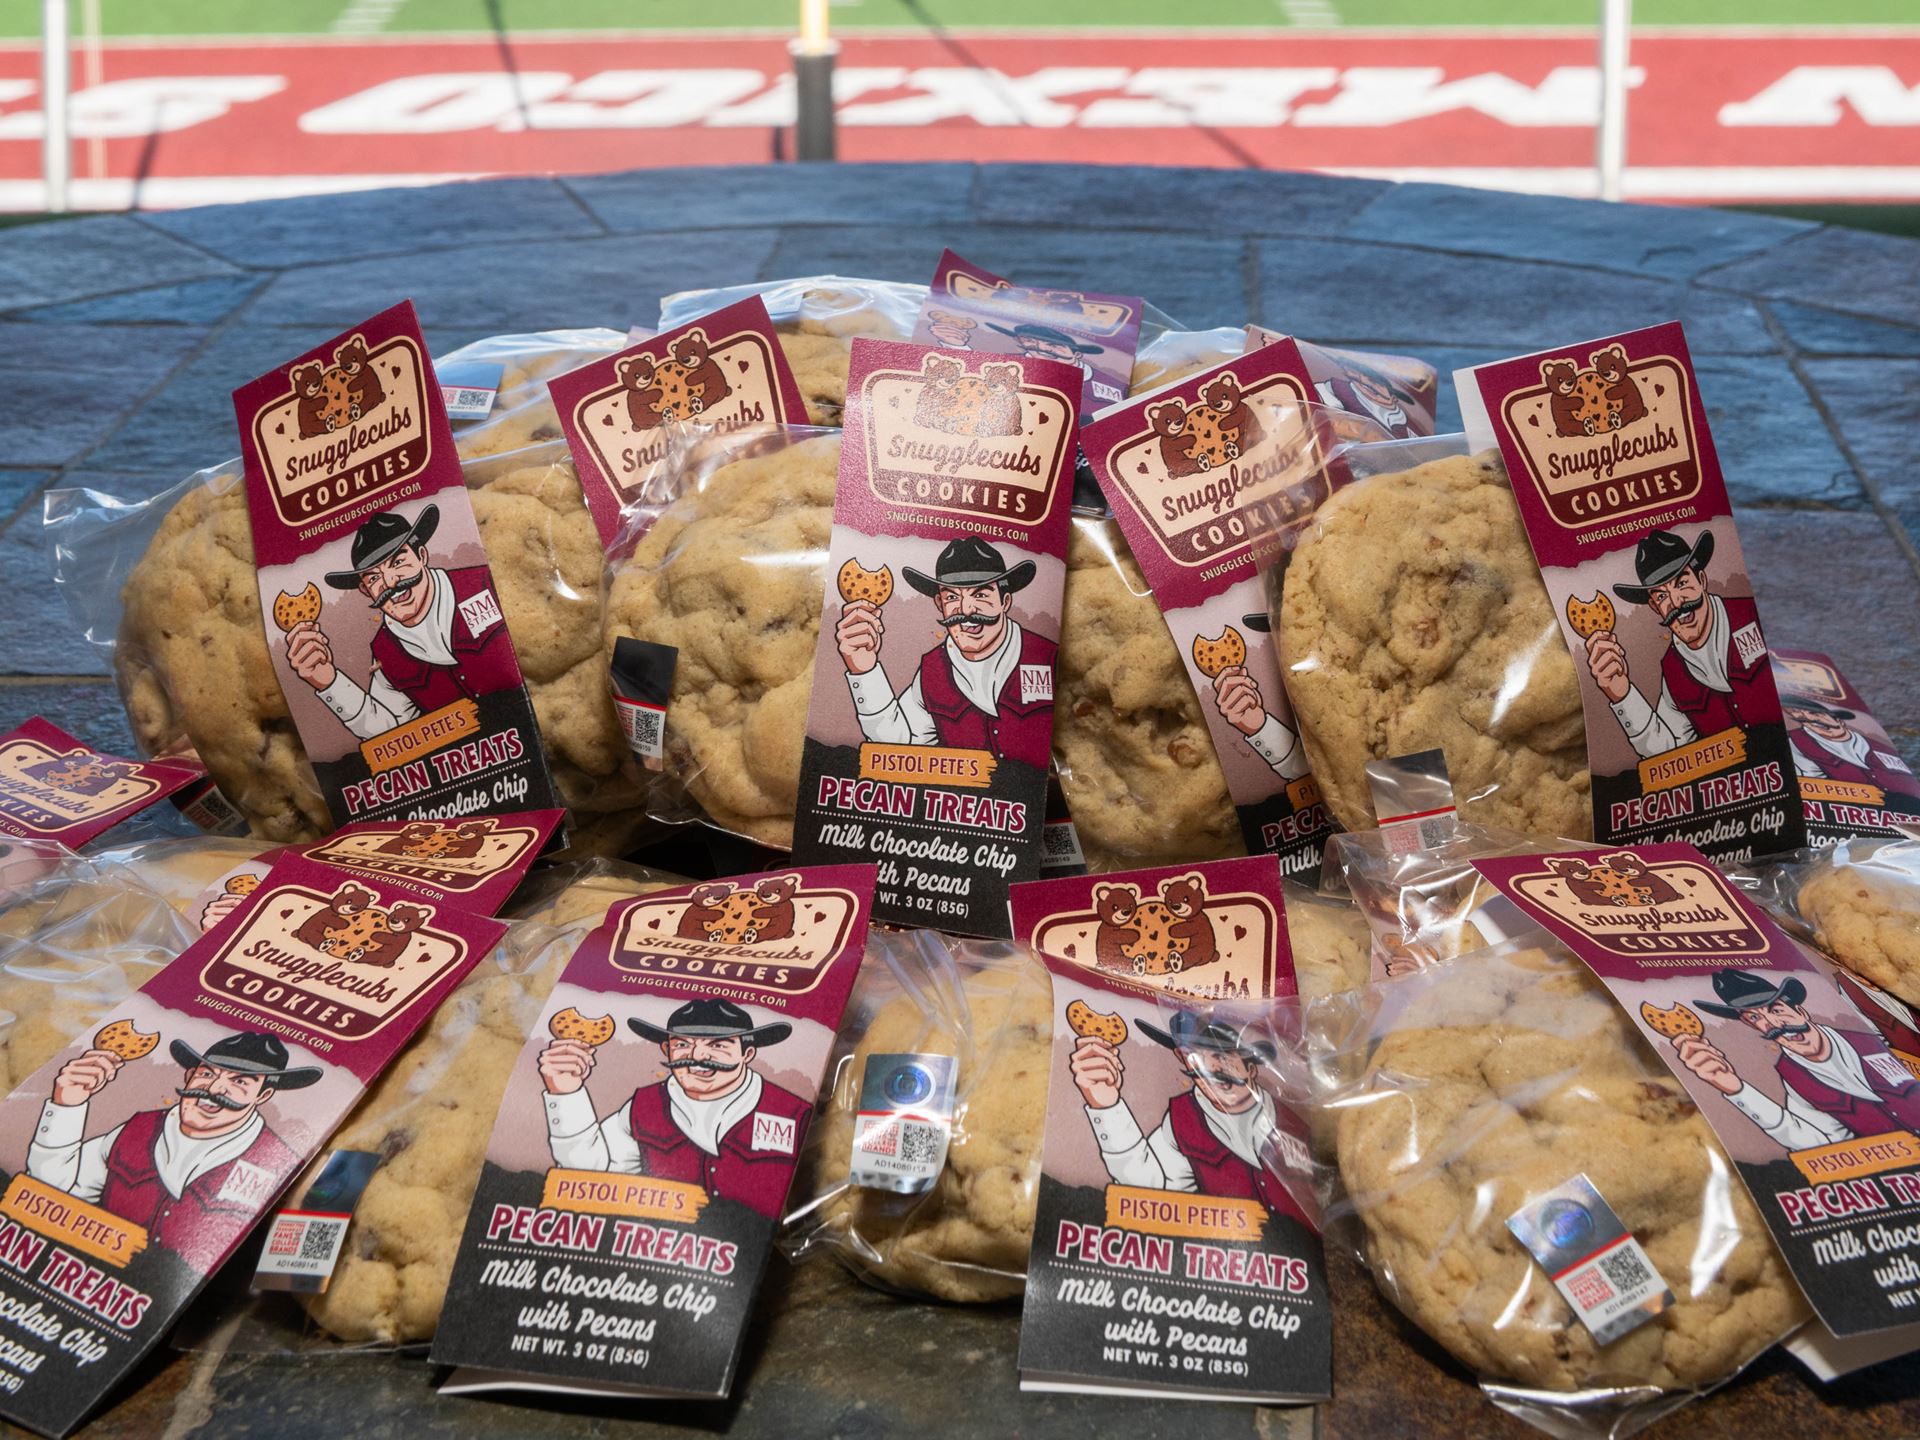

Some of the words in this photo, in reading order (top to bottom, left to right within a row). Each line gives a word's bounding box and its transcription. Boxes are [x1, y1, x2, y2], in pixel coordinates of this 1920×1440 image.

[285, 406, 412, 481] Snugglecubs
[887, 434, 1041, 476] Snugglecubs
[1548, 423, 1679, 480] Snugglecubs
[301, 449, 411, 512] COOKIES
[898, 477, 1027, 513] COOKIES
[1571, 470, 1682, 515] COOKIES
[299, 482, 421, 541] SNUGGLECUBSCOOKIES.COM
[886, 510, 1029, 542] SNUGGLECUBSCOOKIES.COM
[1576, 506, 1697, 546] SNUGGLECUBSCOOKIES.COM
[462, 595, 494, 620] NM
[468, 608, 498, 629] STATE
[1735, 632, 1761, 650] NM
[1740, 641, 1763, 659] STATE
[1021, 669, 1052, 686] NM
[1022, 685, 1052, 695] STATE
[373, 732, 422, 763] PISTOL
[424, 709, 467, 741] PETE'S
[343, 761, 431, 815] PECAN
[431, 728, 524, 783] TREATS
[871, 753, 924, 774] PISTOL
[928, 758, 979, 777] PETE'S
[1649, 756, 1694, 784] PISTOL
[1695, 738, 1735, 767] PETE'S
[493, 773, 528, 803] Chip
[817, 775, 916, 818] PECAN
[924, 790, 1026, 833] TREATS
[1611, 785, 1693, 832] PECAN
[1699, 761, 1783, 810] TREATS
[1826, 784, 1870, 799] PETE'S
[1262, 804, 1328, 848] PECA
[1751, 806, 1785, 836] Chip
[327, 855, 456, 882] COOKIES
[870, 830, 969, 864] Chocolate
[973, 844, 1017, 877] Chip
[904, 866, 971, 896] Pecans
[880, 891, 901, 906] WT.
[905, 895, 913, 908] 3
[916, 897, 933, 911] OZ
[936, 899, 969, 919] (85G)
[1579, 904, 1729, 931] Snugglecubs
[636, 936, 815, 961] Snugglecubs
[1619, 933, 1747, 950] COOKIES
[243, 939, 398, 1004] Snugglecubs
[639, 955, 789, 984] COOKIES
[1636, 958, 1773, 969] SNUGGLECUBSCOOKIES.COM
[225, 973, 356, 1029] COOKIES
[621, 974, 787, 1008] SNUGGLECUBSCOOKIES.COM
[194, 994, 334, 1053] SNUGGLECUBSCOOKIES.COM
[1869, 1056, 1901, 1072] NM
[756, 1116, 794, 1139] NM
[1806, 1151, 1863, 1174] PISTOL
[1861, 1141, 1912, 1162] PETE'S
[556, 1180, 619, 1202] PISTOL
[624, 1186, 686, 1211] PETE'S
[1775, 1178, 1890, 1226] PECAN
[14, 1188, 71, 1227] PISTOL
[70, 1214, 128, 1251] PETE'S
[1119, 1198, 1181, 1223] PISTOL
[1187, 1205, 1247, 1229] PETE'S
[486, 1203, 605, 1253] PECAN
[610, 1219, 738, 1275] TREATS
[1056, 1219, 1174, 1274] PECAN
[1183, 1242, 1309, 1294] TREATS
[1873, 1253, 1920, 1287] with
[38, 1247, 153, 1330] TREATS
[541, 1265, 658, 1307] Chocolate
[663, 1283, 717, 1322] Chip
[1887, 1290, 1917, 1308] NET
[517, 1300, 571, 1332] with
[574, 1308, 656, 1343] Pecans
[1121, 1286, 1243, 1326] Chocolate
[1248, 1304, 1301, 1339] Chip
[59, 1327, 108, 1368] Chip
[511, 1335, 539, 1352] NET
[542, 1338, 567, 1357] WT.
[573, 1342, 583, 1358] 3
[586, 1343, 606, 1361] OZ
[609, 1346, 650, 1368] (85G)
[1104, 1319, 1160, 1347] with
[1166, 1325, 1248, 1356] Pecans
[1103, 1347, 1133, 1362] NET
[1136, 1350, 1163, 1367] WT.
[1169, 1355, 1178, 1369] 3
[1183, 1355, 1204, 1371] OZ
[1208, 1357, 1249, 1377] (85G)
